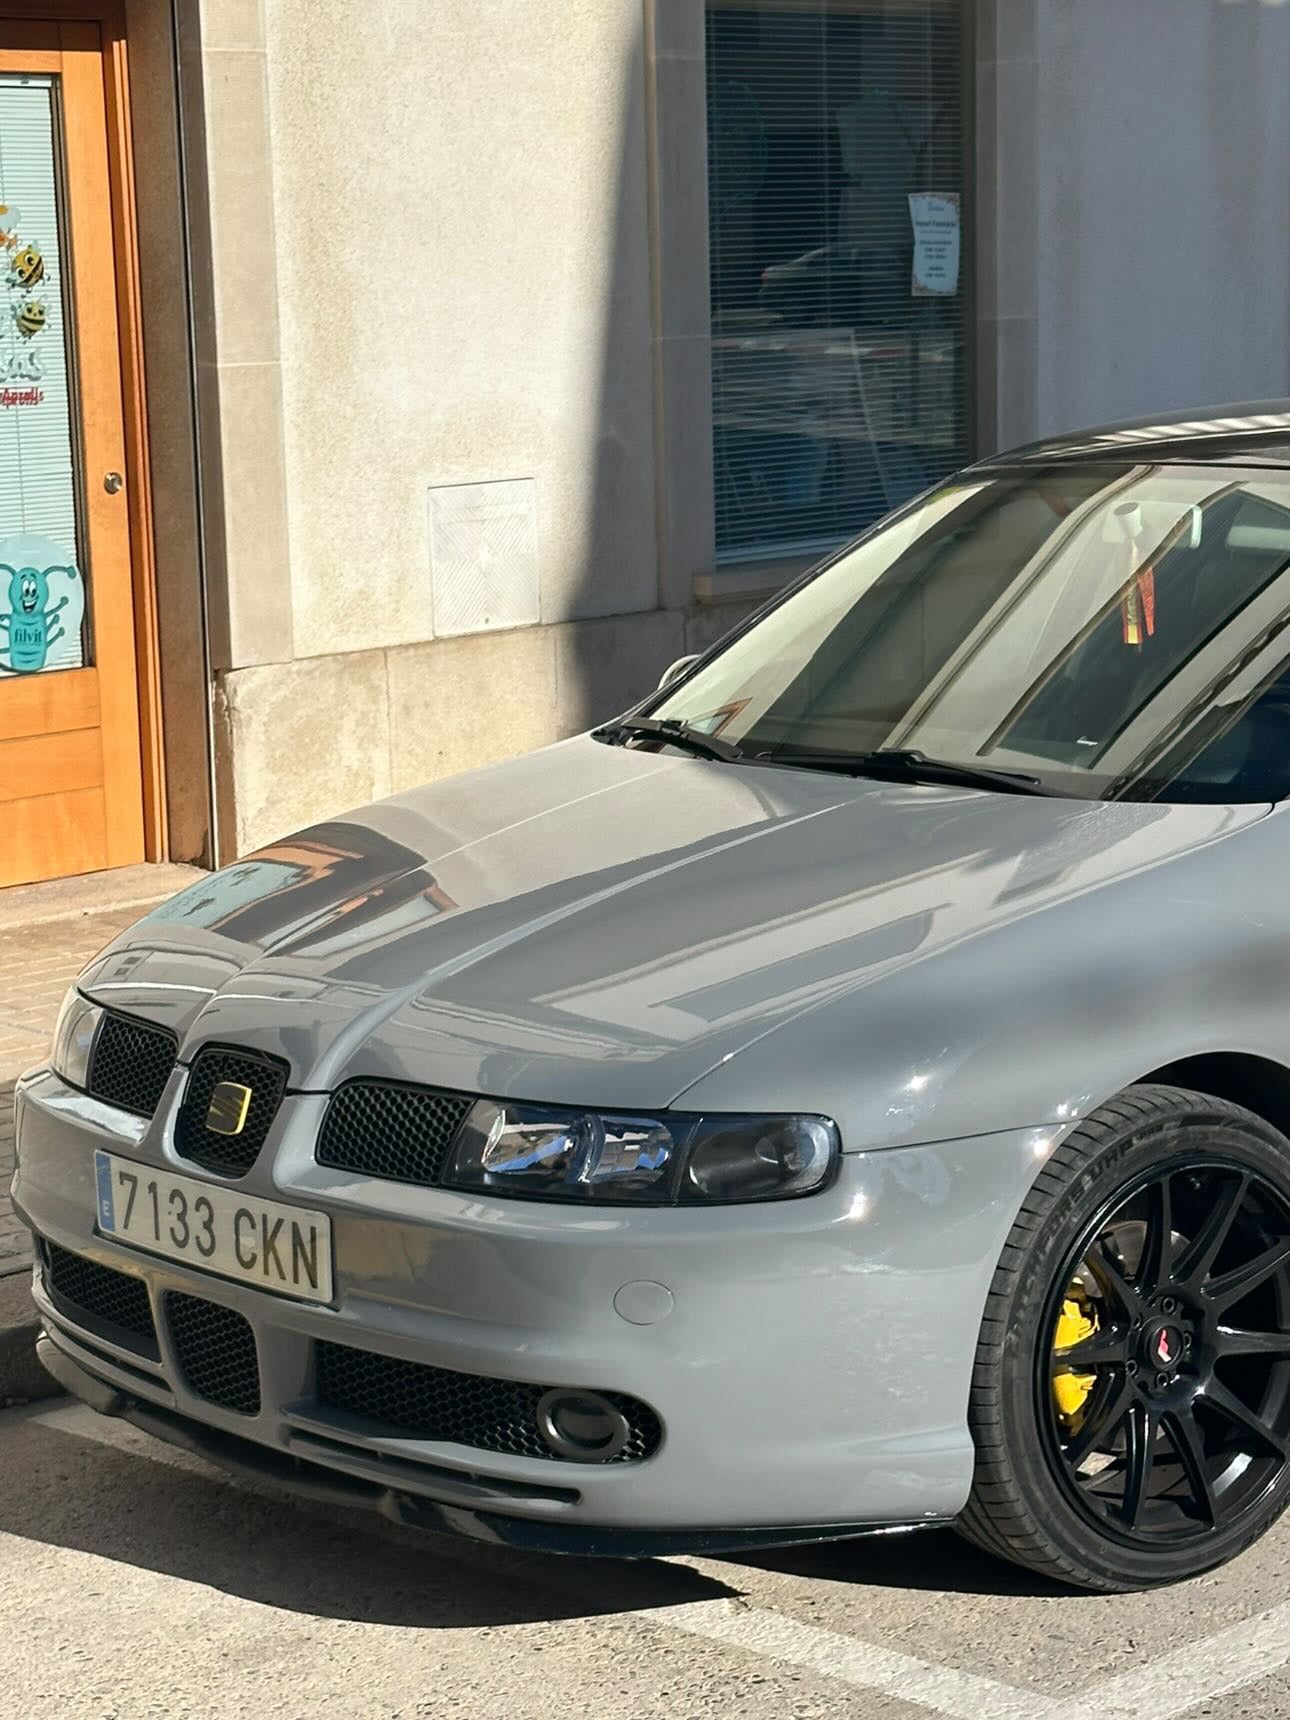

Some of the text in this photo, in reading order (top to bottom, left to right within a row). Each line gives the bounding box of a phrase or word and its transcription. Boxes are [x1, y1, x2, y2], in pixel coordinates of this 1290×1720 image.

[14, 628, 42, 643] filvit
[103, 1200, 110, 1217] E
[120, 1173, 318, 1289] 7133 CKN
